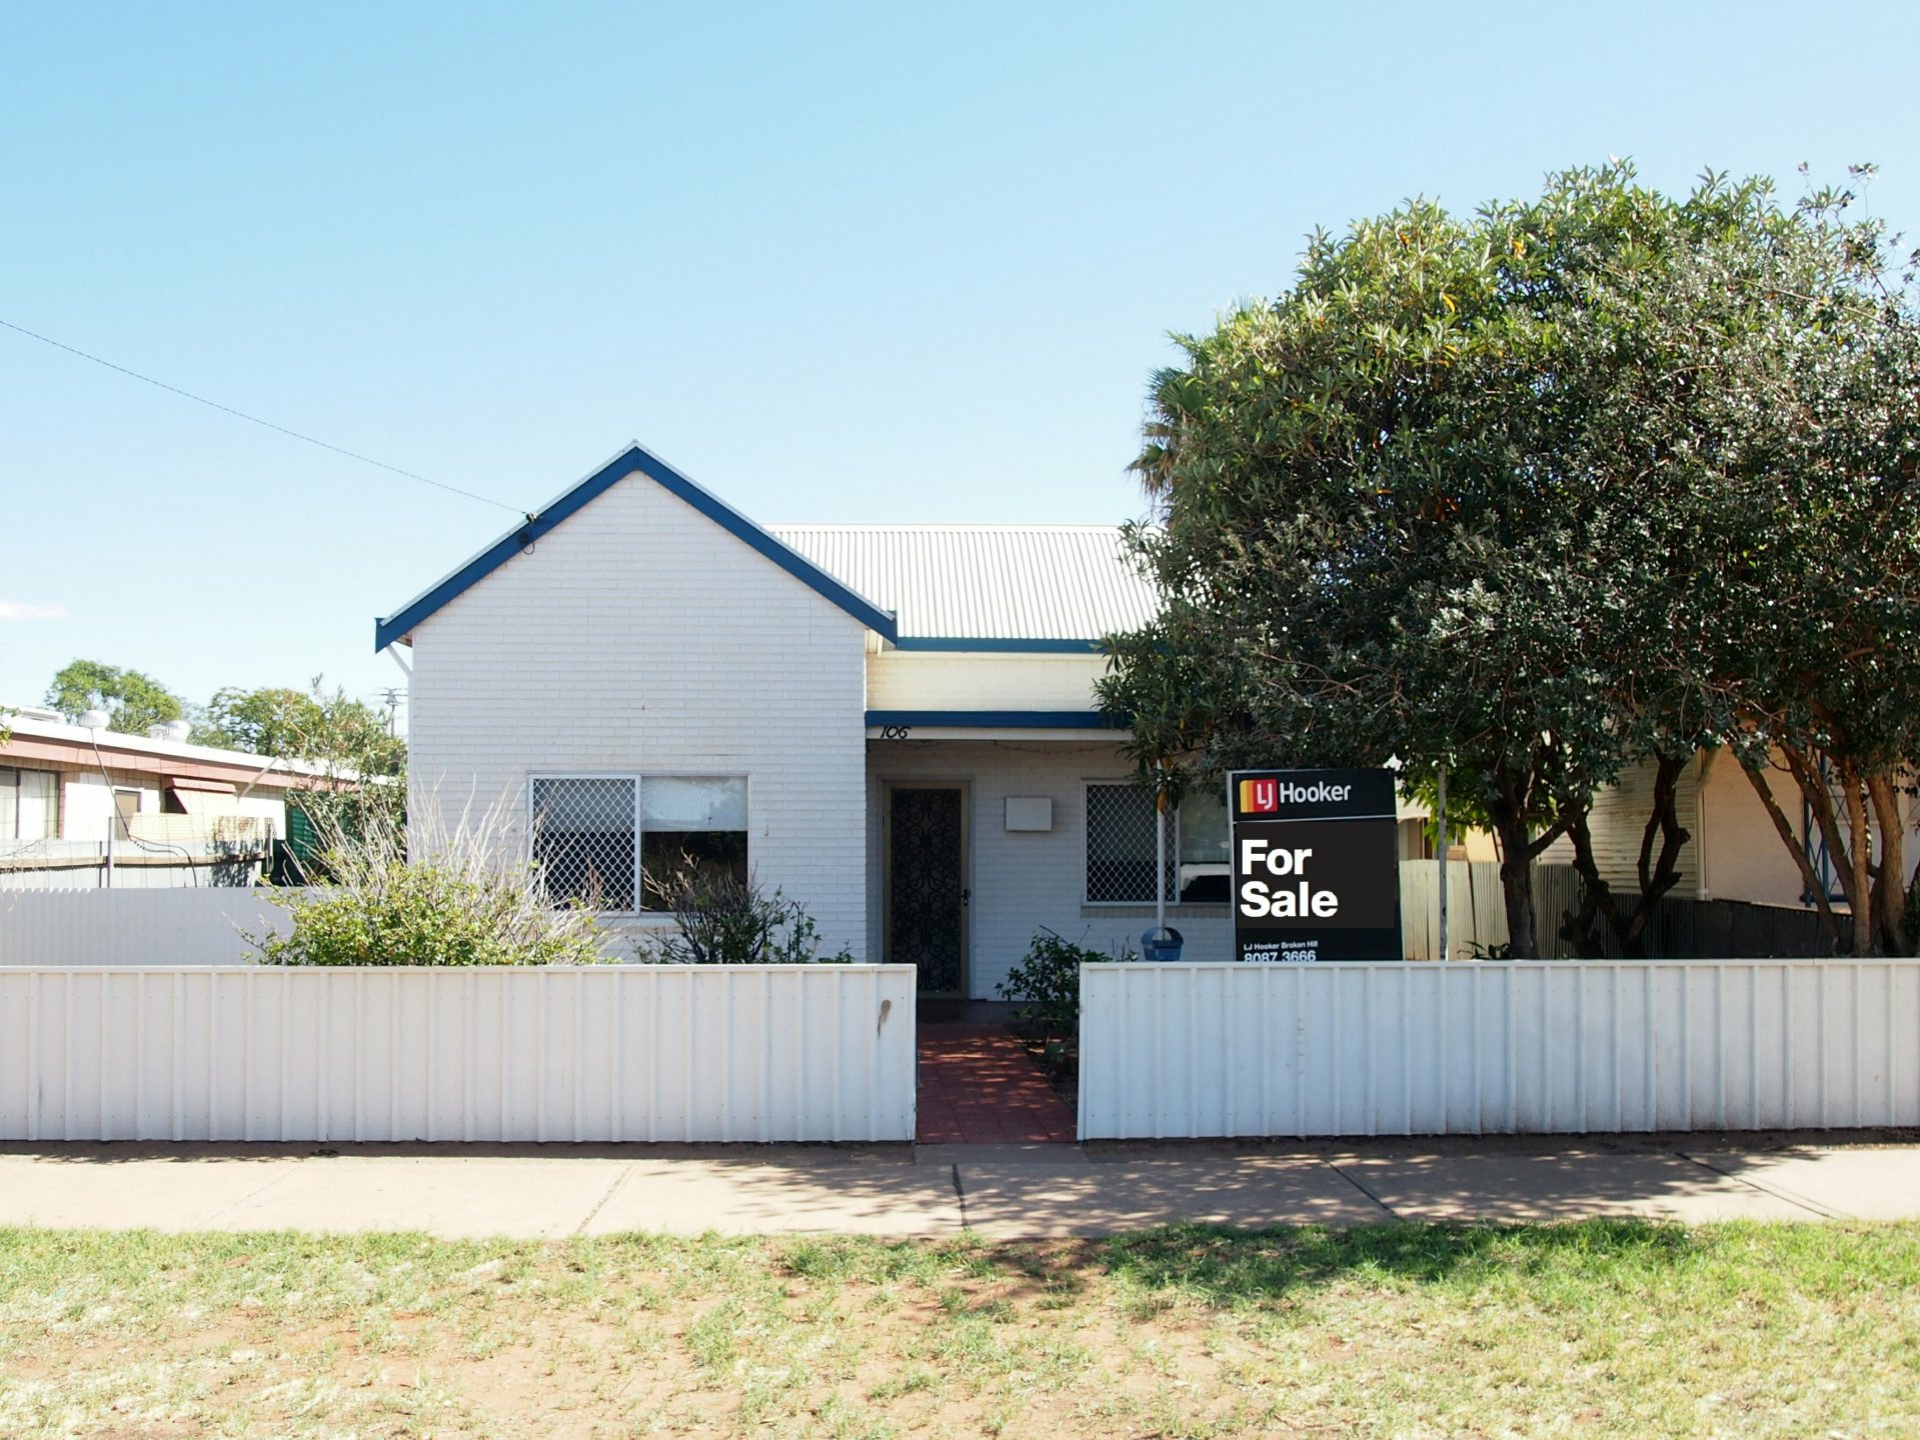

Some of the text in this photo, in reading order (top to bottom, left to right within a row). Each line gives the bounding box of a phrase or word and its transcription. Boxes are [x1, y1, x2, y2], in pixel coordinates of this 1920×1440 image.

[881, 726, 911, 739] 106
[1257, 781, 1352, 810] LJ Hooker
[1242, 840, 1313, 875] For
[1240, 881, 1339, 918] Sale
[1243, 940, 1319, 951] LJ Hooker Broken Hill
[1244, 950, 1317, 962] 8087 3666
